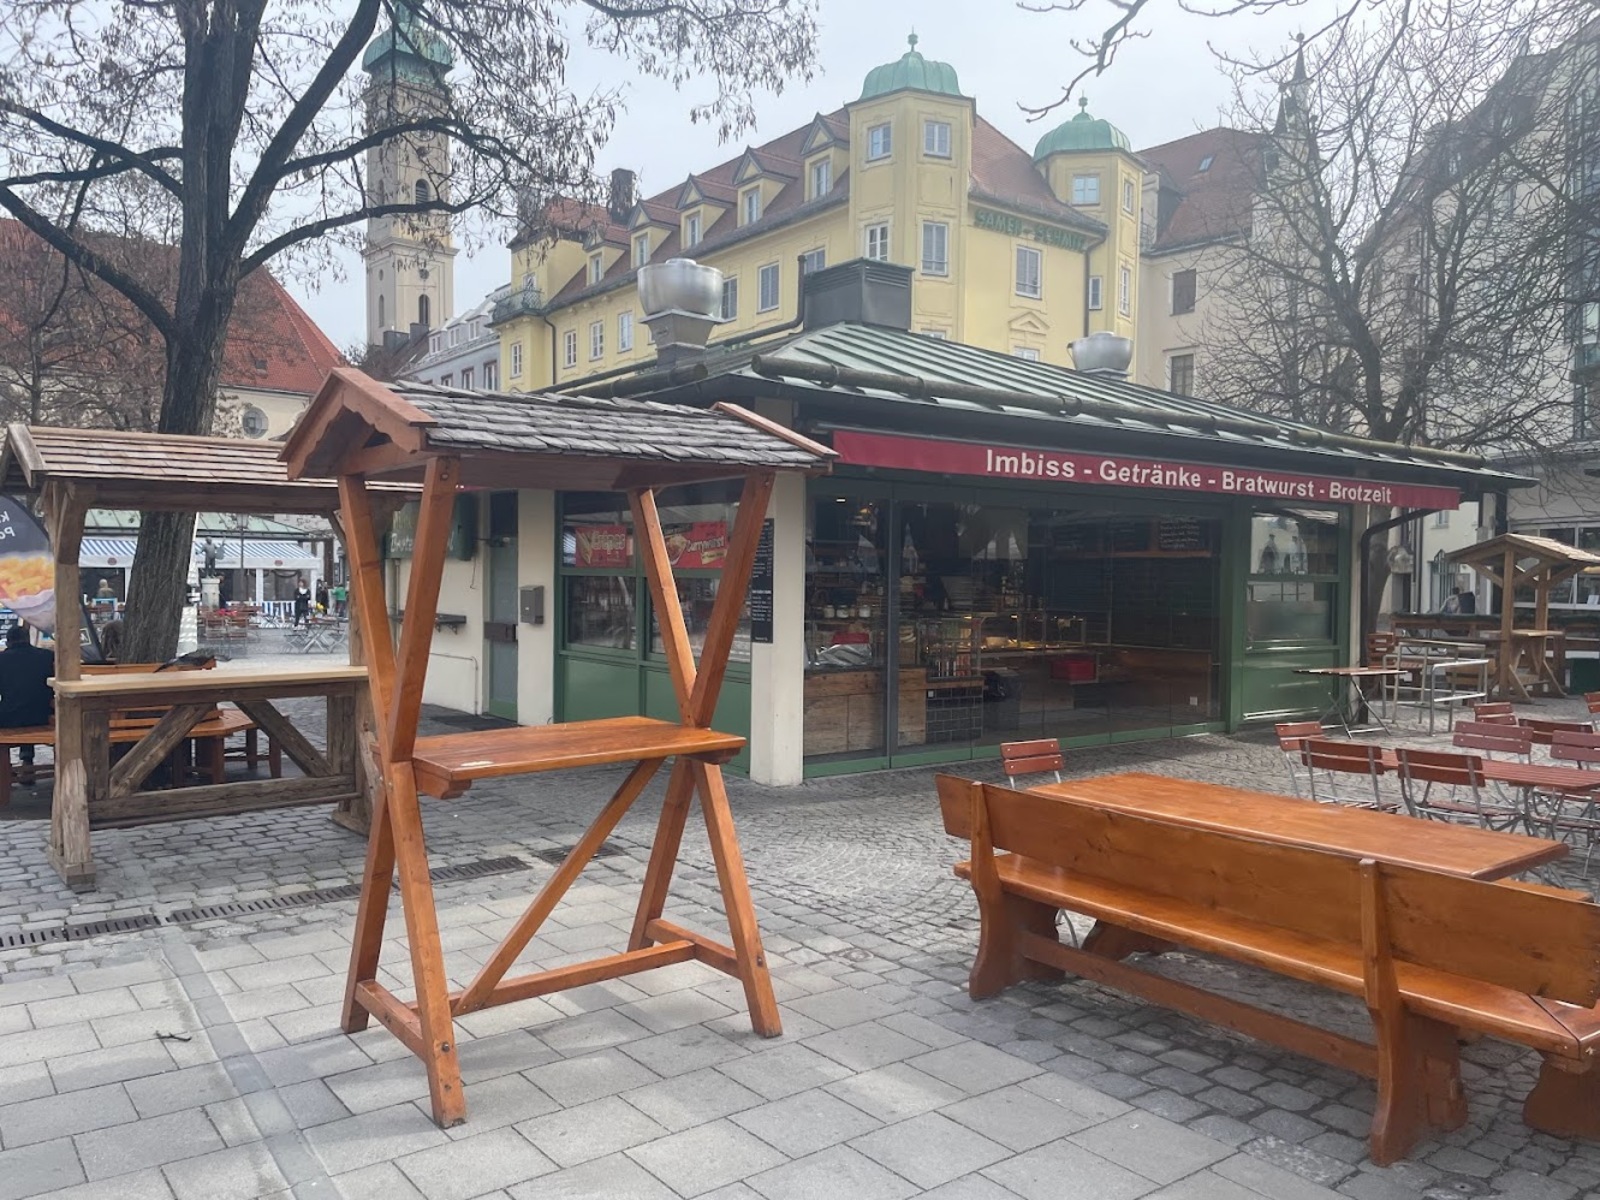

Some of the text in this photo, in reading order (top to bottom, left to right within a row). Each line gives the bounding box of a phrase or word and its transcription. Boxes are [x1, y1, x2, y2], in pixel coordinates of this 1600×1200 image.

[986, 449, 1076, 478] Imbiss
[1099, 460, 1202, 489] Getränke
[1222, 471, 1315, 498] Bratwurst
[1328, 481, 1392, 504] Brotzeit
